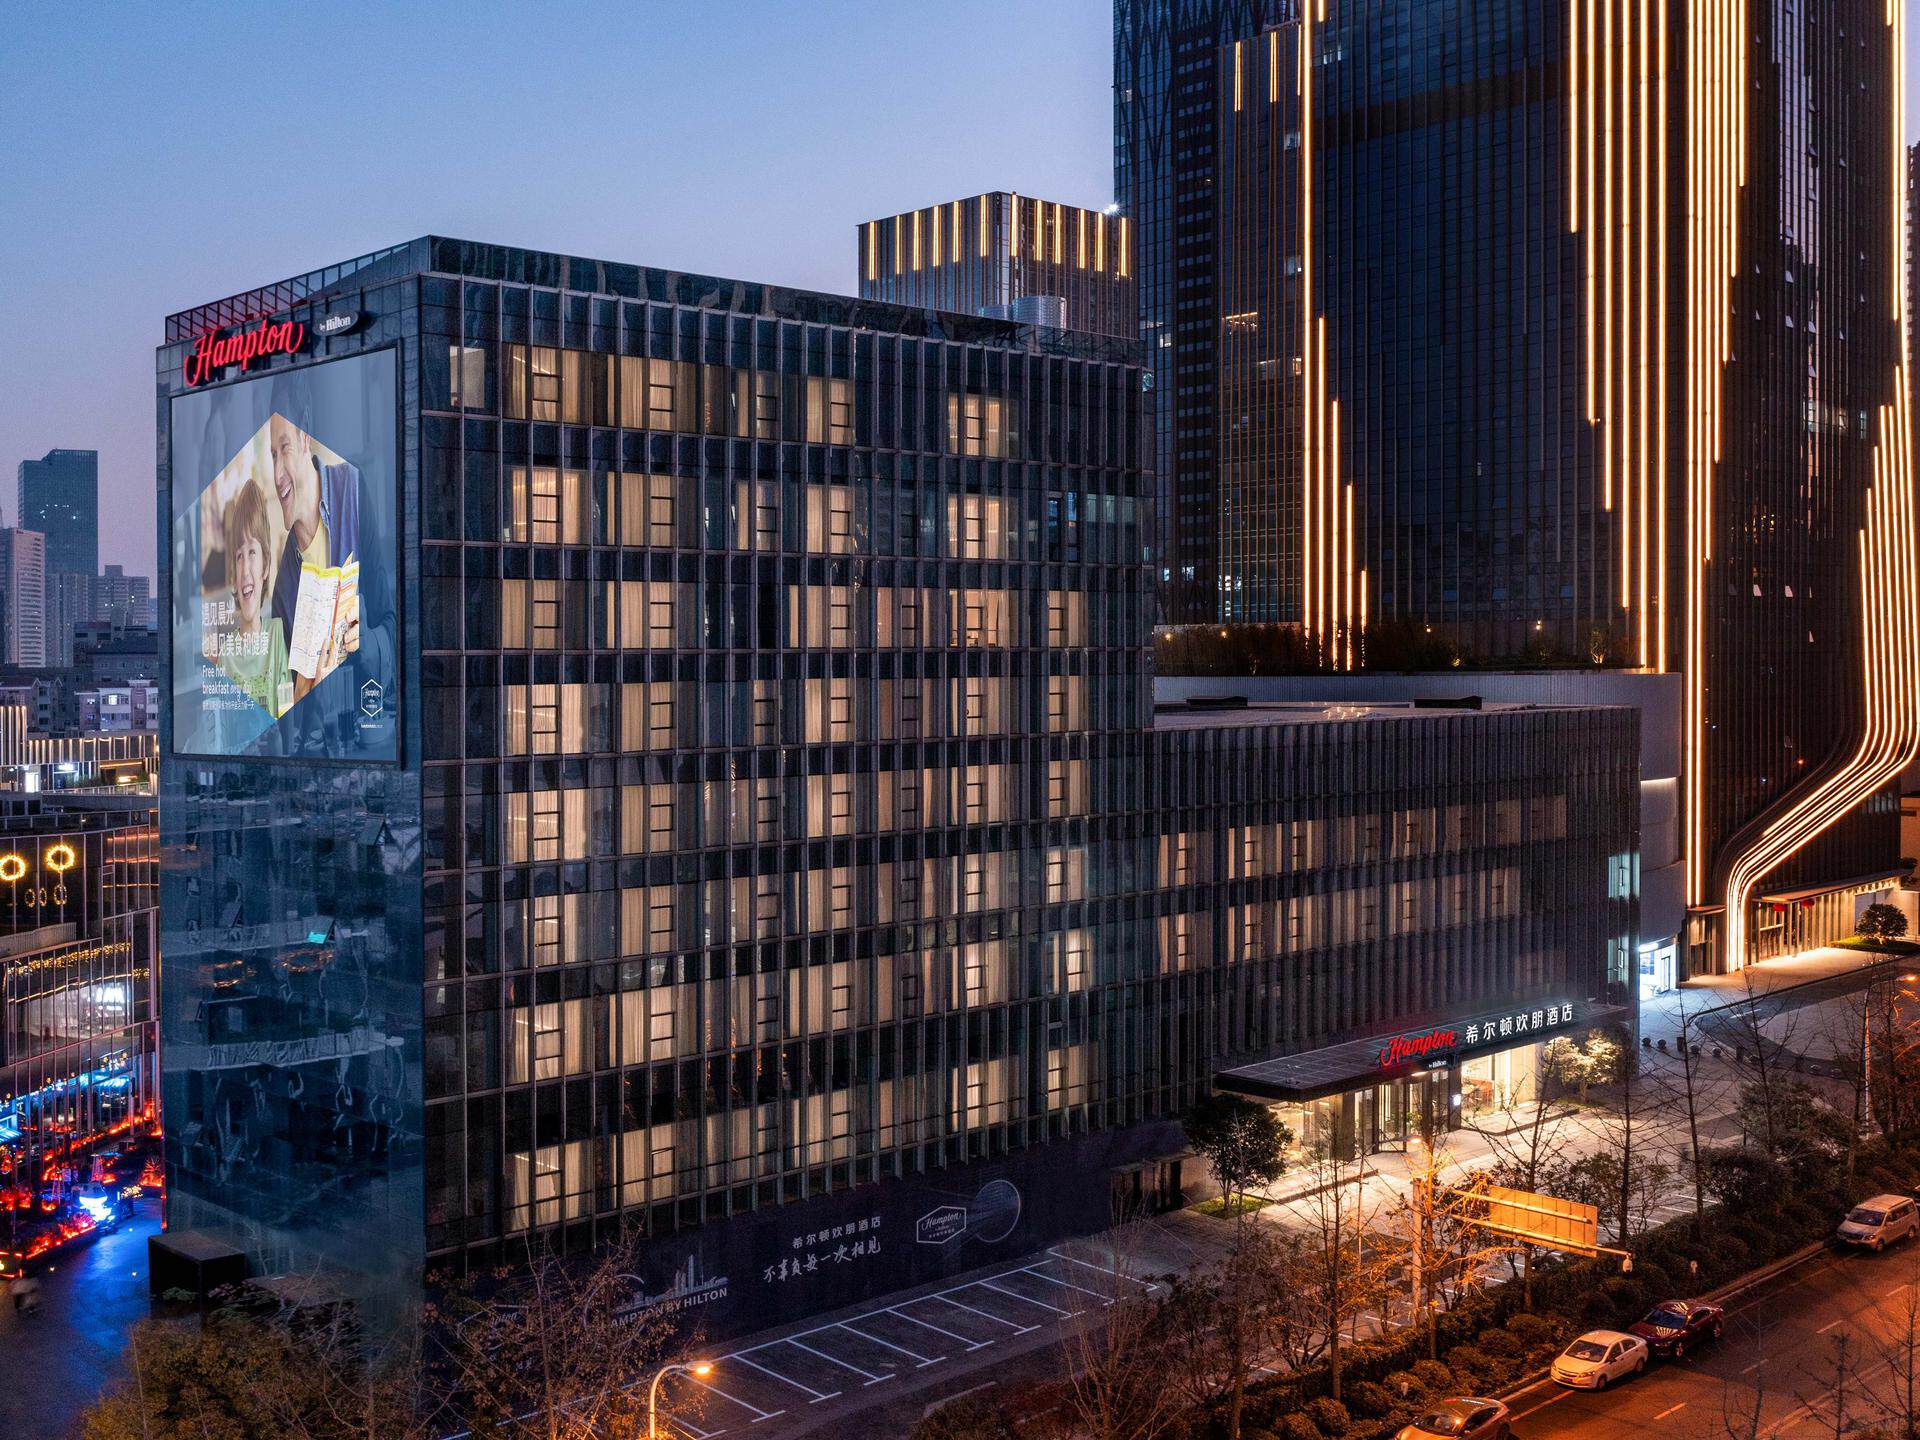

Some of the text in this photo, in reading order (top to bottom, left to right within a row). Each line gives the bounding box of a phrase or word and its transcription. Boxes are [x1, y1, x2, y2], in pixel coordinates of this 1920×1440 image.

[326, 316, 351, 331] Hilton
[183, 319, 303, 387] Hampton
[202, 600, 235, 625] 遇见晨光
[202, 631, 269, 657] 也遇见美食和健康
[202, 664, 226, 678] Free hot
[202, 681, 229, 695] breakfast
[1465, 1003, 1573, 1044] 希尔顿欢朋酒店
[1379, 1029, 1457, 1066] Hampton
[792, 1216, 881, 1249] 希尔顿欢朋酒店
[921, 1212, 962, 1231] Hampton
[763, 1235, 882, 1283] 不辜负每一次相见
[610, 1287, 728, 1326] AMPTON BY HILTON
